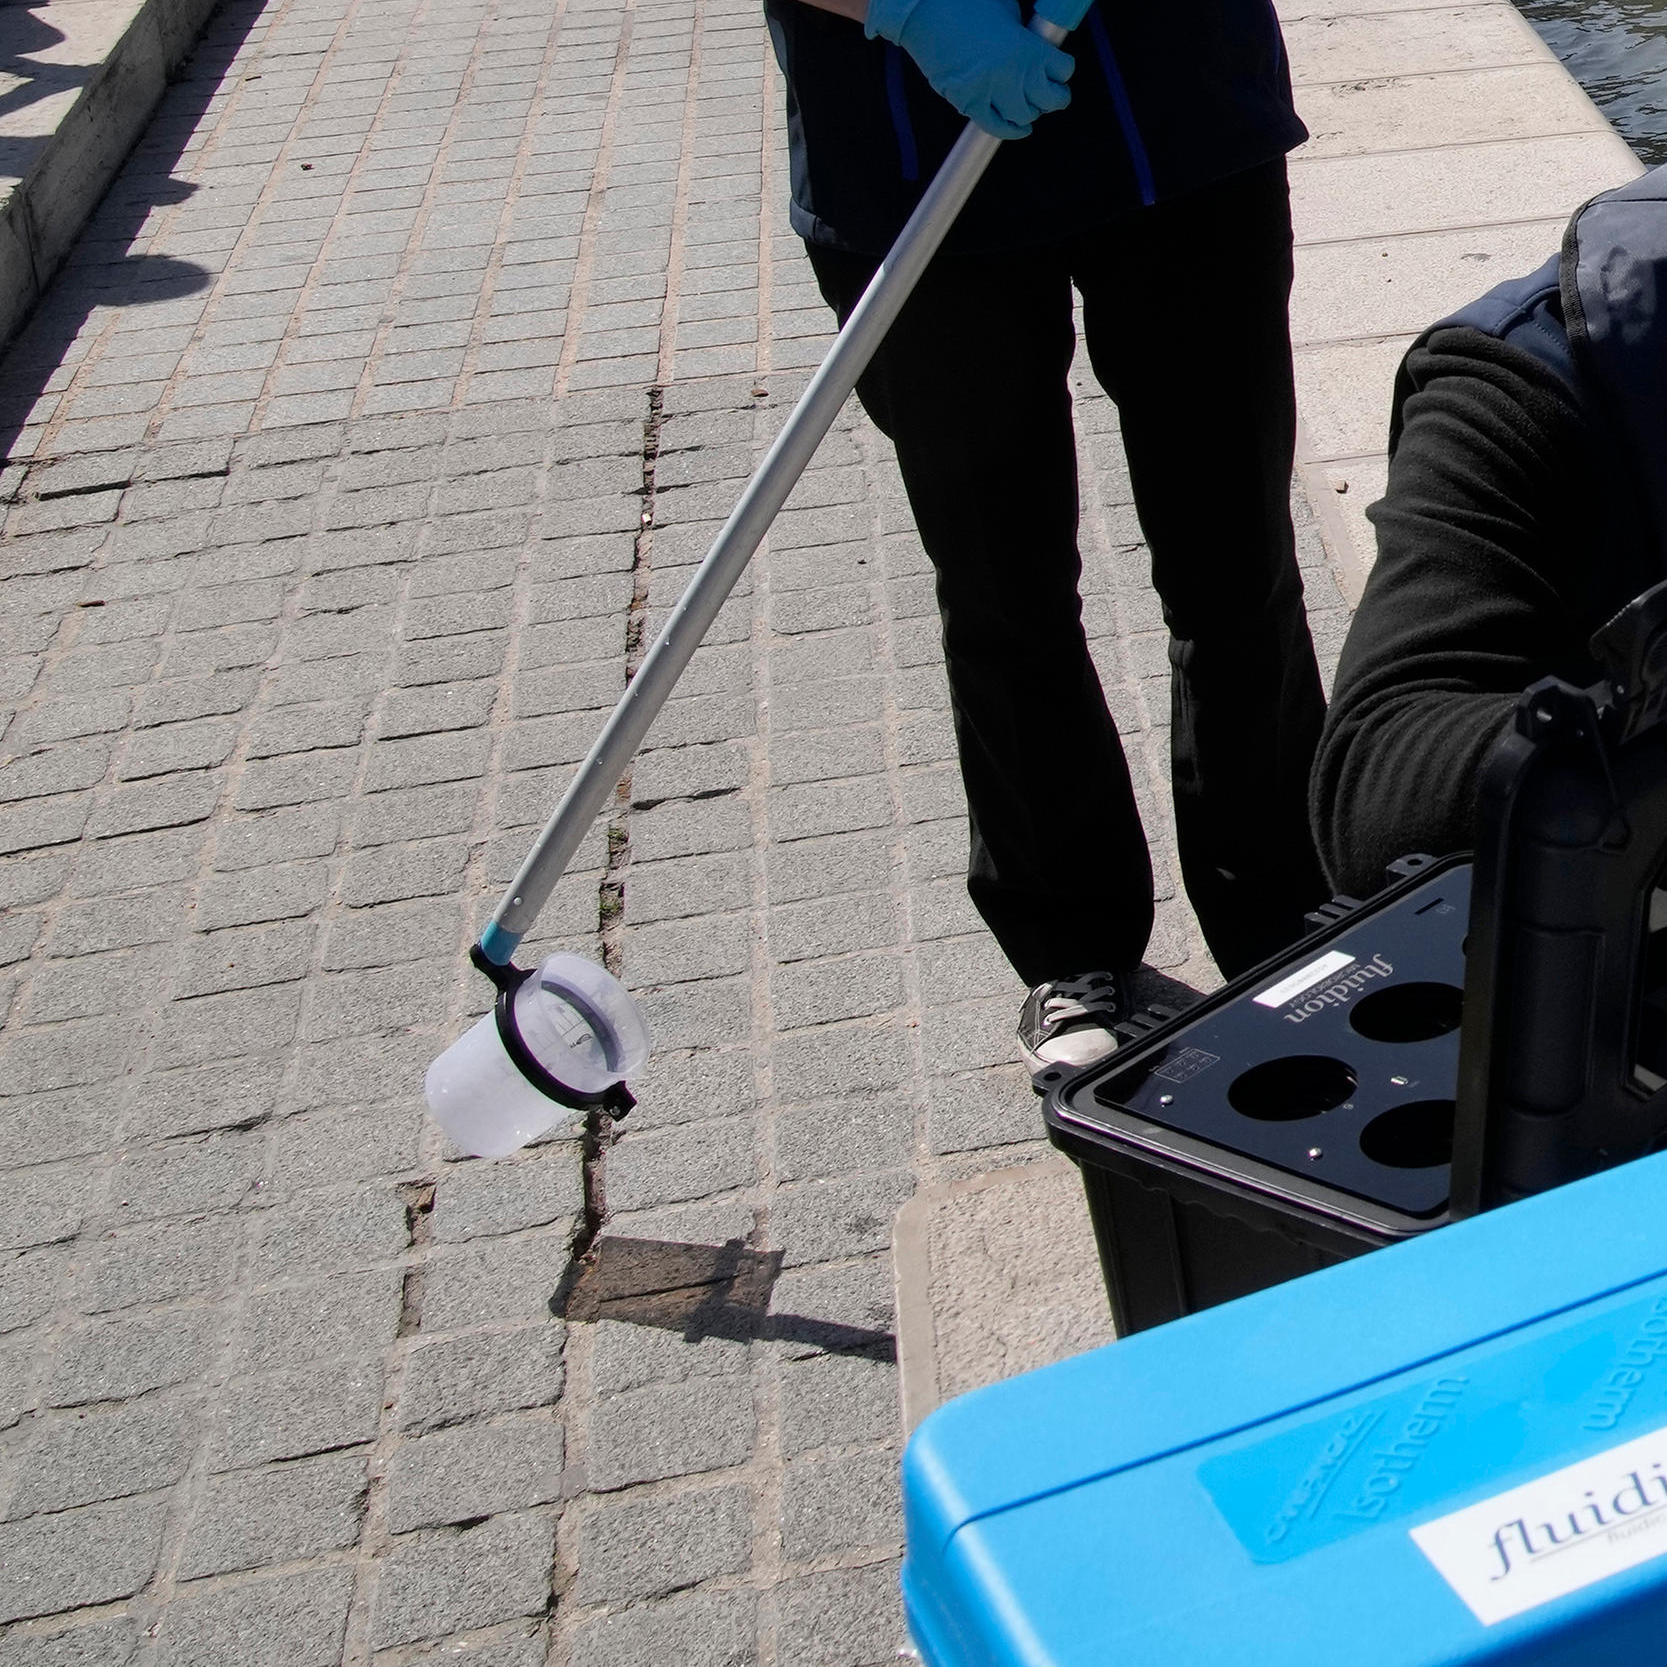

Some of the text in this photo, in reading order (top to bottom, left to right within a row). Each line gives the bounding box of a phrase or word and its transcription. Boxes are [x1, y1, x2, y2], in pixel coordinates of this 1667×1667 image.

[1283, 953, 1394, 1023] fluidion
[1332, 1374, 1470, 1522] Isotherm
[1606, 1516, 1667, 1545] fluidic
